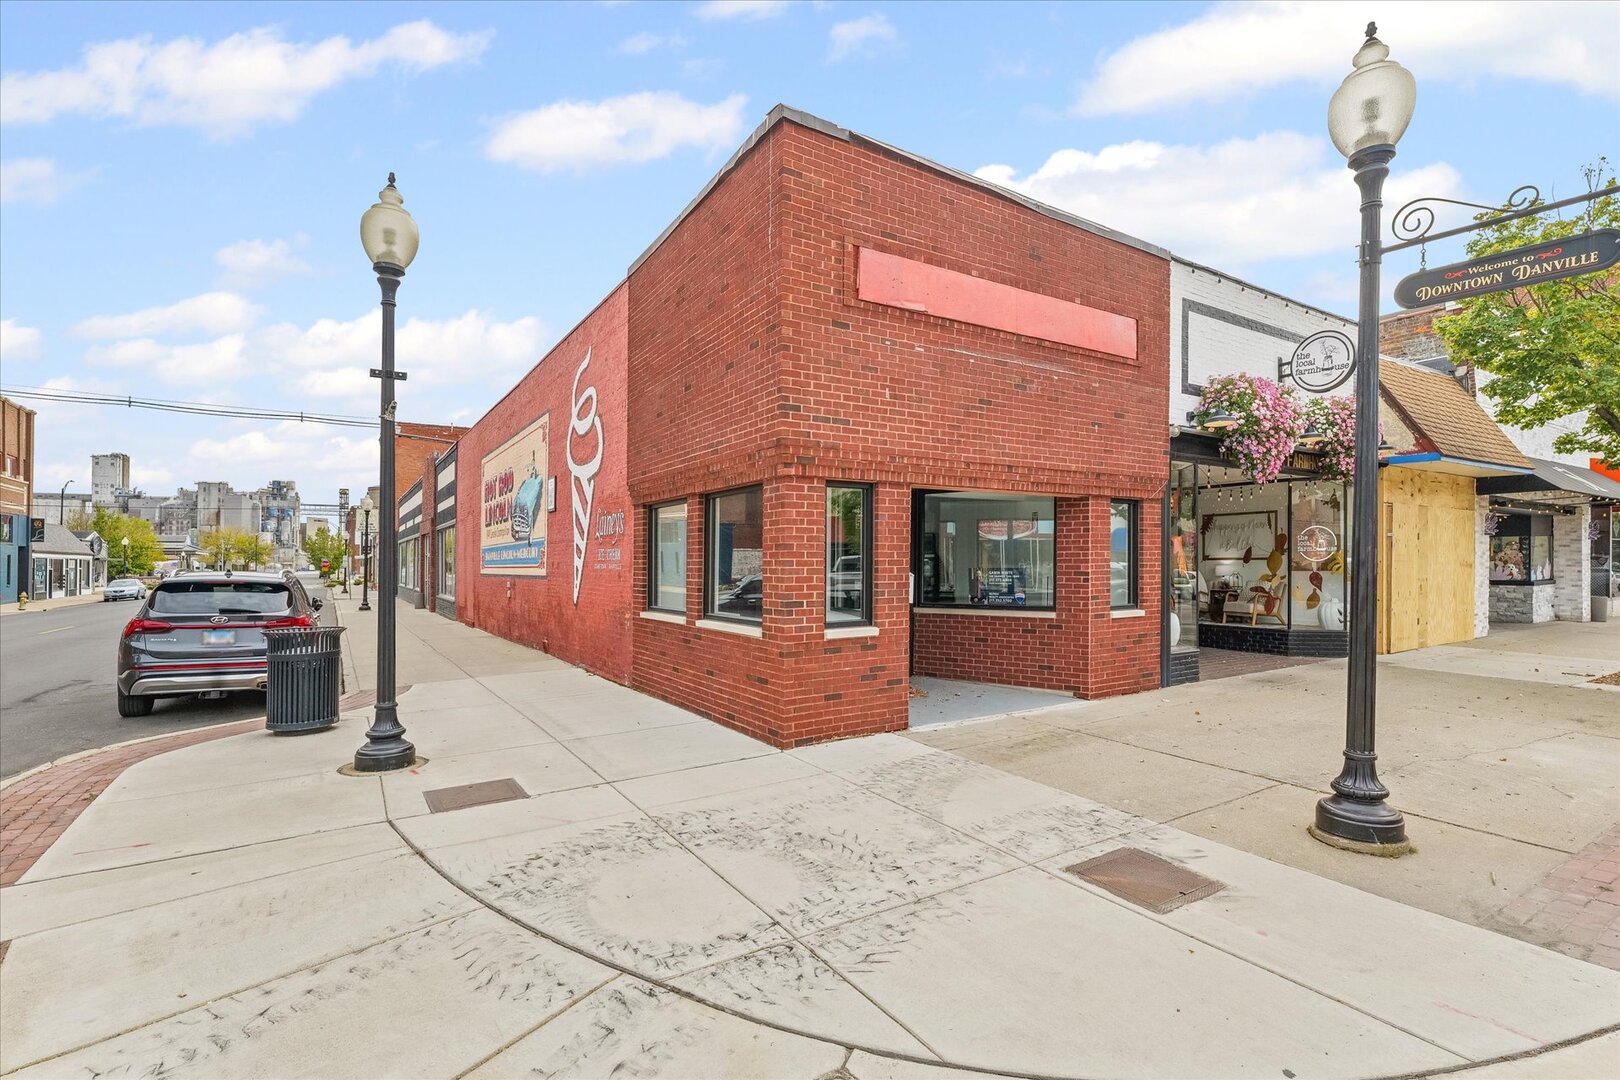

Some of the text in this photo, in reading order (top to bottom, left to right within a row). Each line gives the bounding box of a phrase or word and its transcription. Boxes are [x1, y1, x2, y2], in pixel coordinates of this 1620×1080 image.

[1416, 251, 1599, 301] DOWNTOWN DANVILLE
[1467, 254, 1534, 276] Welcome to
[1295, 362, 1350, 376] farmhuse
[1296, 358, 1316, 368] local
[595, 508, 624, 544] Lainey's
